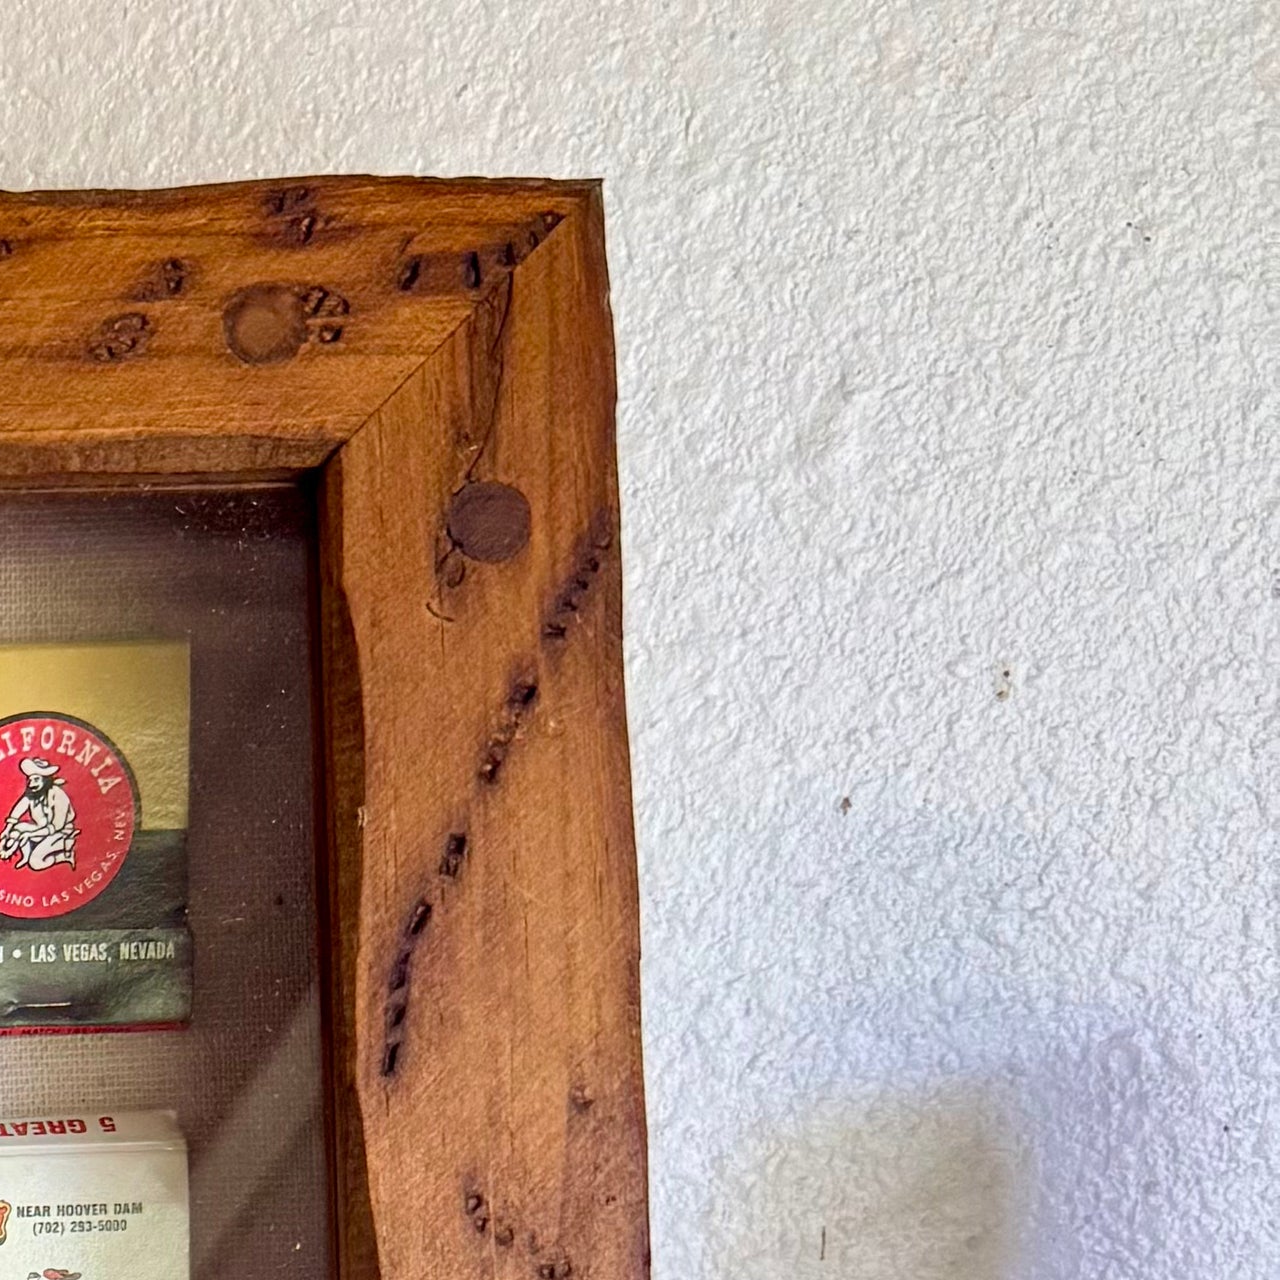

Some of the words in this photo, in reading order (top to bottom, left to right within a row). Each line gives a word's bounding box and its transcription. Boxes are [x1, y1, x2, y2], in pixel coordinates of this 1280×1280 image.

[42, 893, 70, 907] LAS
[31, 944, 56, 963] LAS
[63, 944, 111, 963] VEGAS,
[120, 942, 175, 959] NEVADA
[98, 1117, 117, 1133] 5
[17, 1205, 50, 1218] NEAR
[57, 1203, 108, 1217] HOOVER
[114, 1202, 142, 1215] DAM
[33, 1220, 65, 1235] (702)
